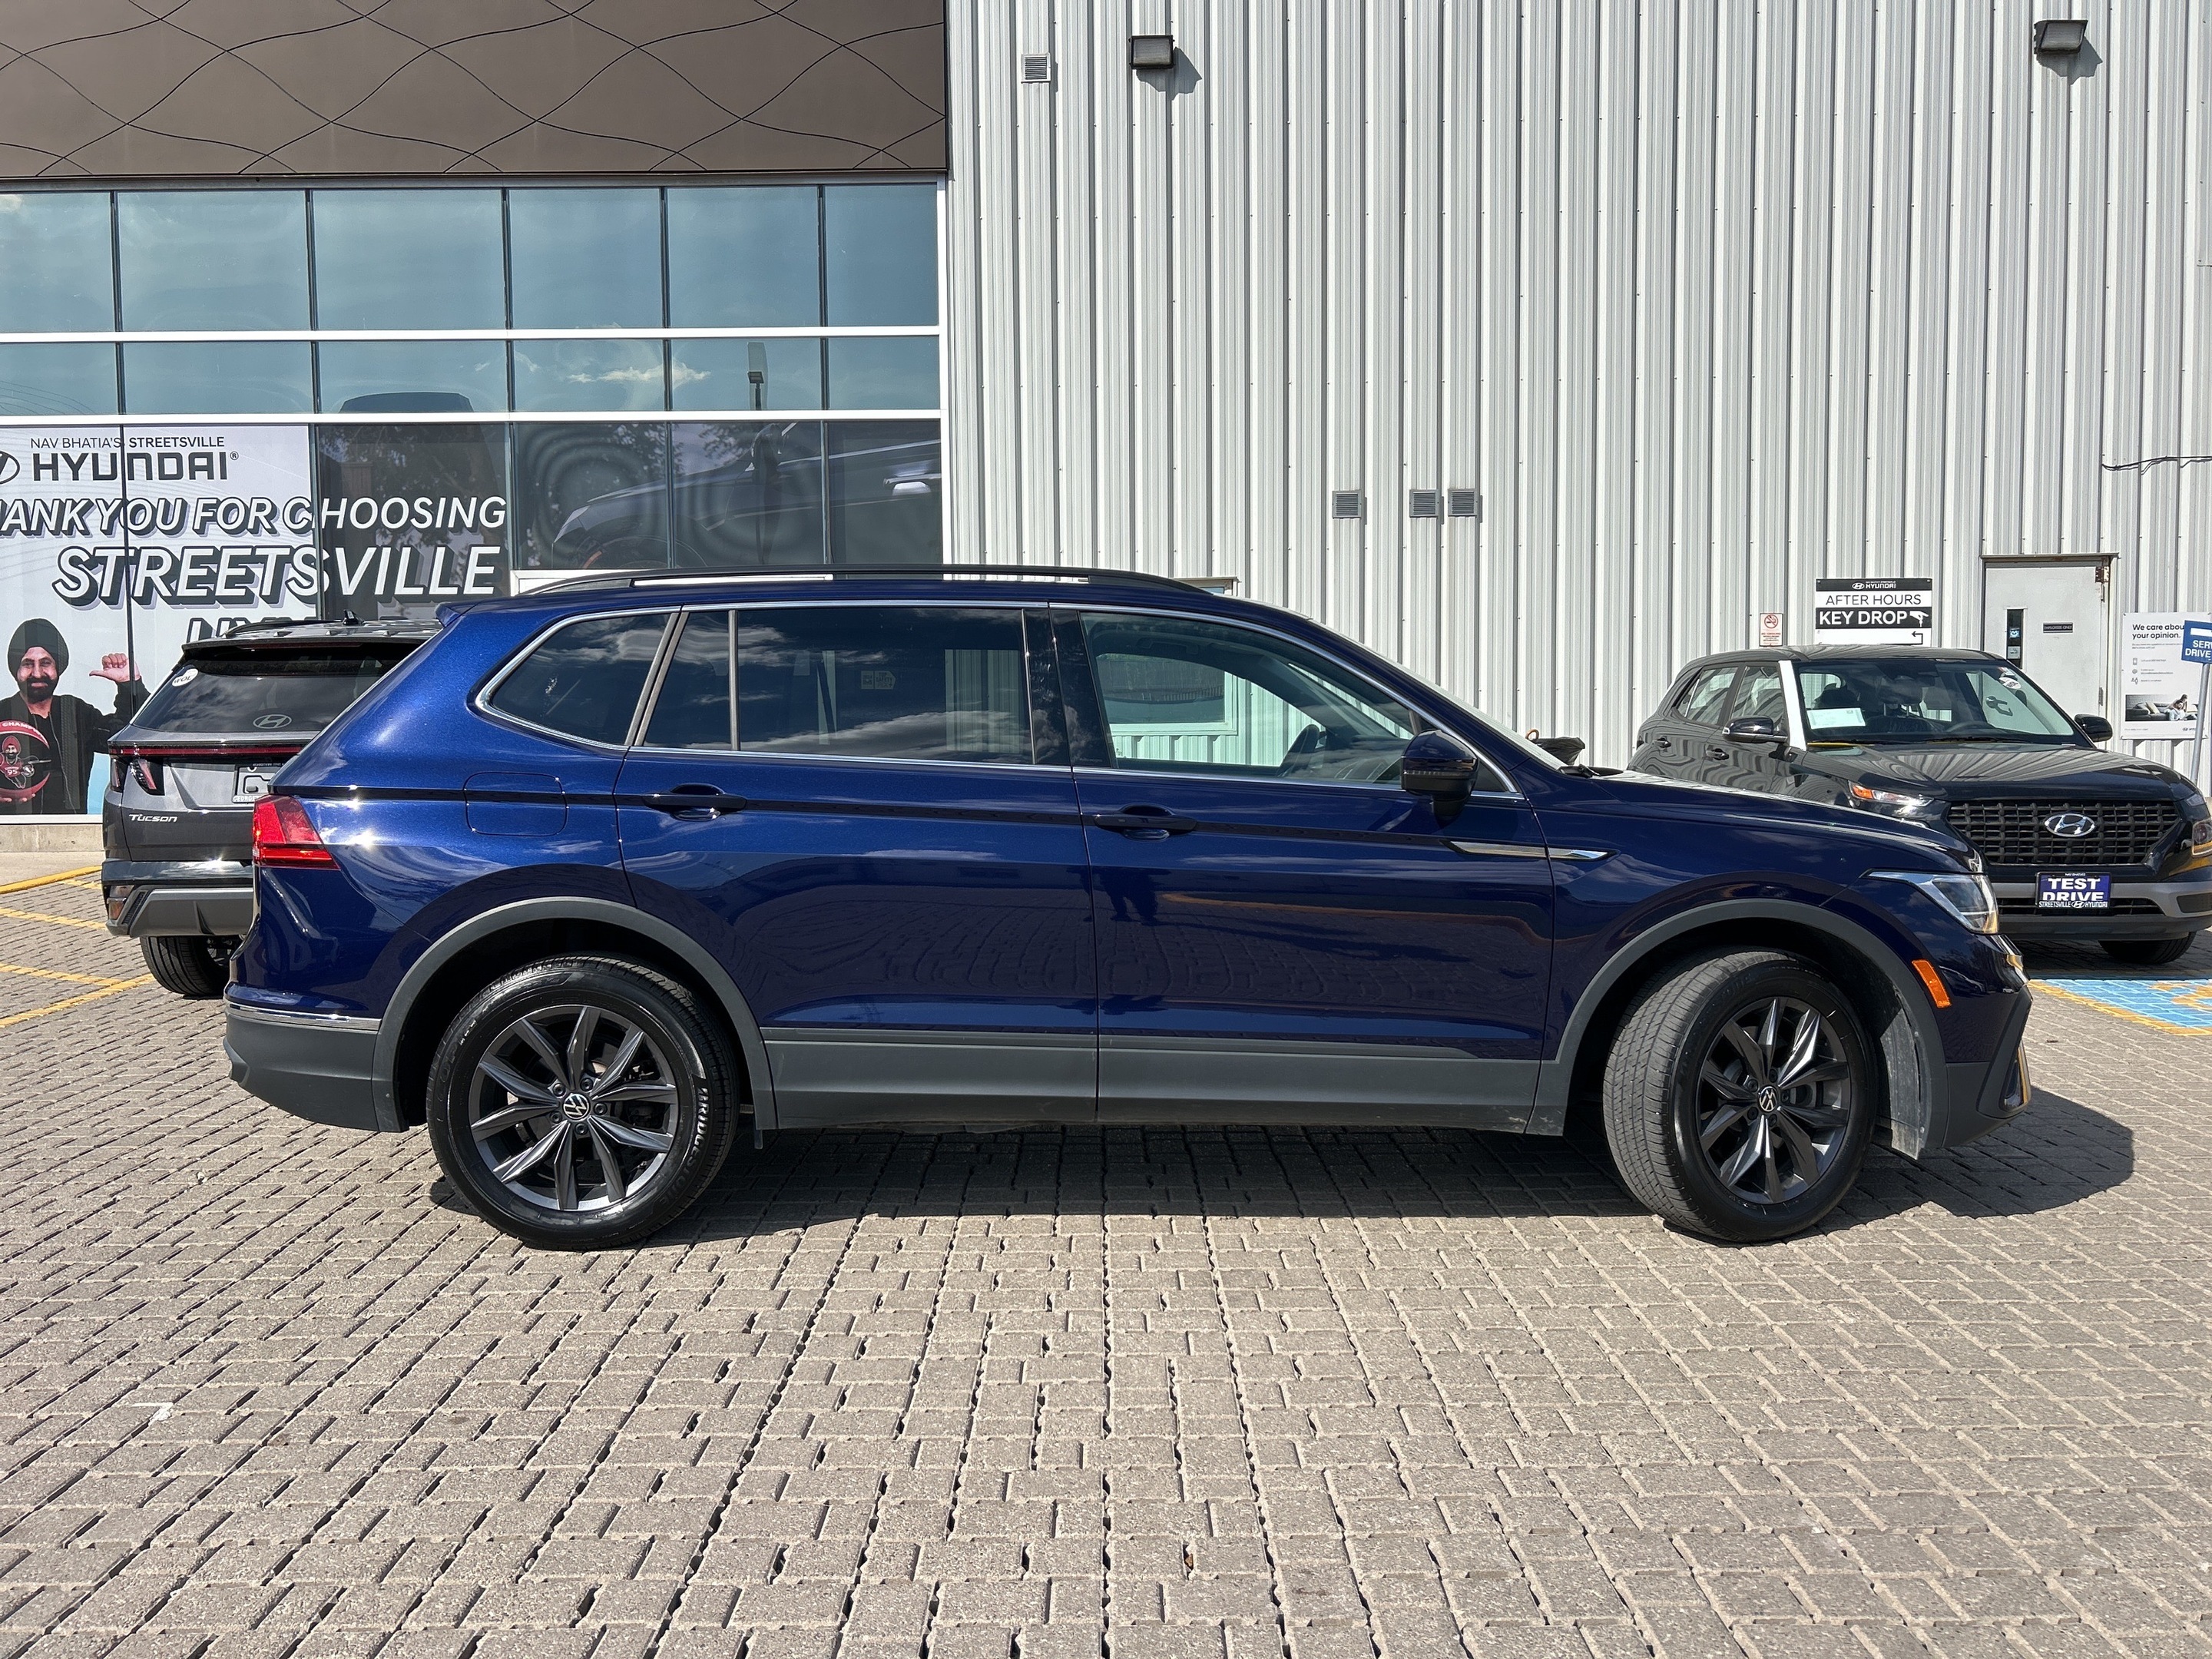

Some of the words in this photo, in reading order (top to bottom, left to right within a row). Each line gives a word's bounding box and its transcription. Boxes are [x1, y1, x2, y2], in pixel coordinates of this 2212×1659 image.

[31, 438, 58, 449] NAV
[63, 438, 121, 449] BHATIA'S
[129, 437, 224, 448] STREETSVILLE
[0, 498, 93, 535] ANK
[95, 498, 187, 535] YOU
[193, 497, 280, 535] FOR
[283, 495, 507, 531] CHOOSING
[51, 545, 502, 605] STREETSVILLE
[1826, 594, 1869, 605] AFTER
[1873, 594, 1922, 605] HOURS
[1819, 611, 1855, 625] KEY
[1858, 610, 1908, 624] DROP
[2150, 631, 2181, 640] opinion.
[2184, 647, 2211, 658] DRIVE
[2048, 878, 2101, 890] TEST
[2042, 891, 2104, 902] DRIVE
